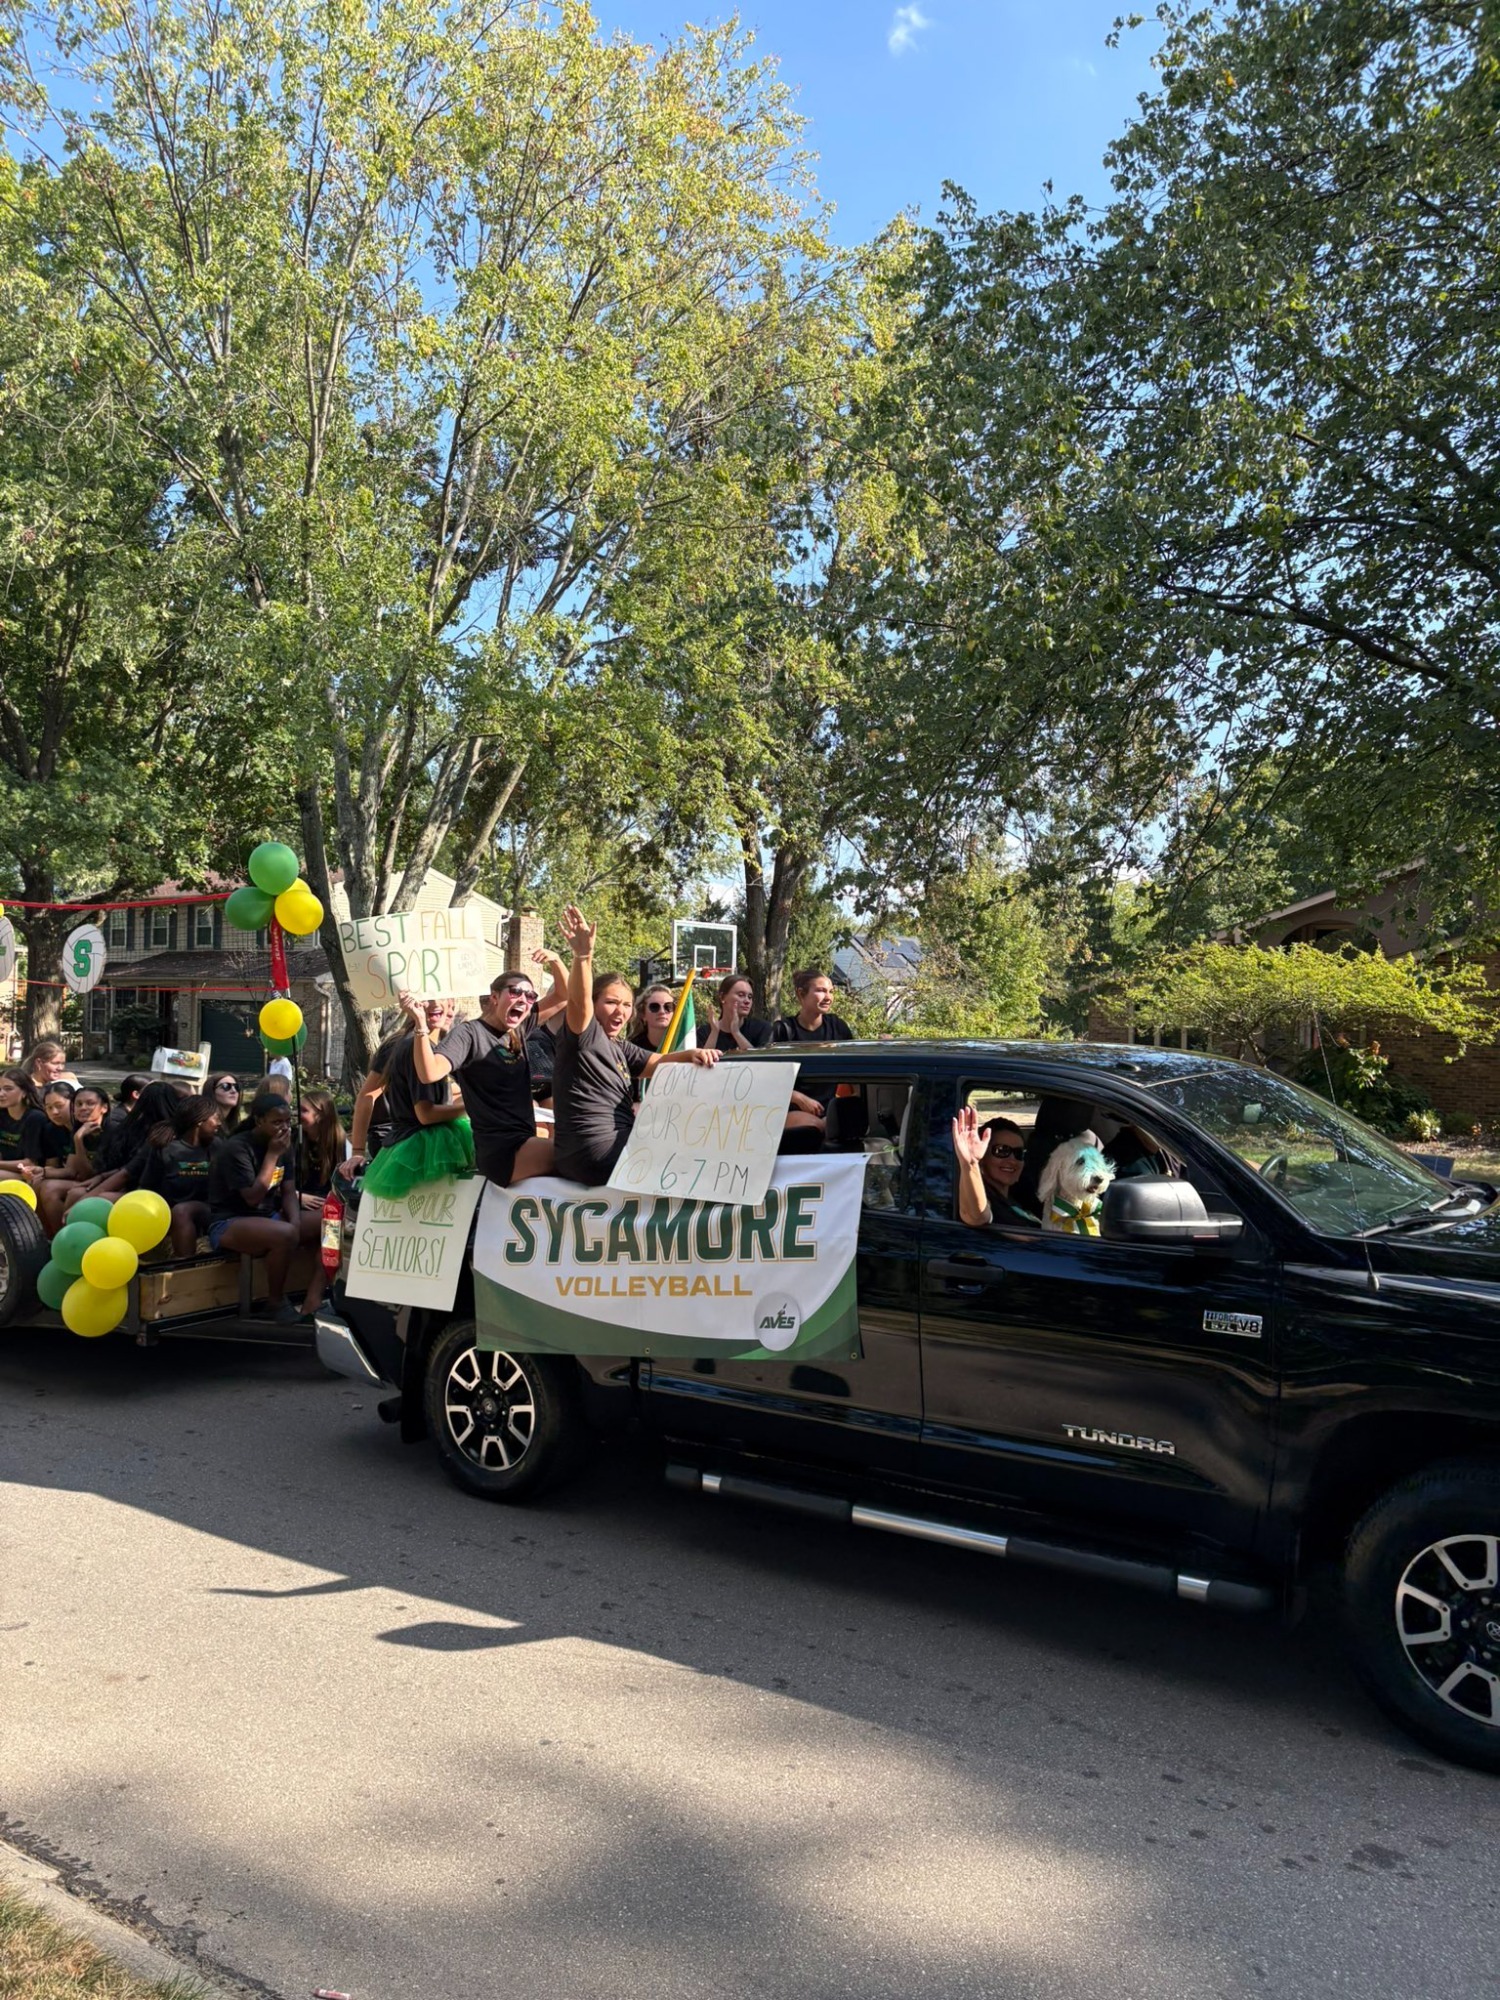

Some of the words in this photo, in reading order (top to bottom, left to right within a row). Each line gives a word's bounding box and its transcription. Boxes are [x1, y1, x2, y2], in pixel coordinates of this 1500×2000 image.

[340, 913, 410, 953] BEST
[420, 910, 476, 941] FALL
[73, 939, 92, 977] S
[367, 947, 457, 999] SPORT
[651, 1065, 699, 1098] COME
[722, 1066, 753, 1100] TO
[635, 1104, 682, 1142] OUR
[684, 1104, 782, 1156] GAMES
[660, 1153, 706, 1194] 6-7
[714, 1161, 749, 1196] PM
[374, 1197, 403, 1218] WE
[422, 1193, 456, 1222] OUR
[503, 1183, 825, 1266] SYCAMORE
[358, 1228, 446, 1277] SENIORS!
[555, 1275, 752, 1297] VOLLEYBALL
[759, 1315, 796, 1329] AVES
[1240, 1319, 1260, 1333] V8
[1061, 1424, 1176, 1455] TUNDRA
